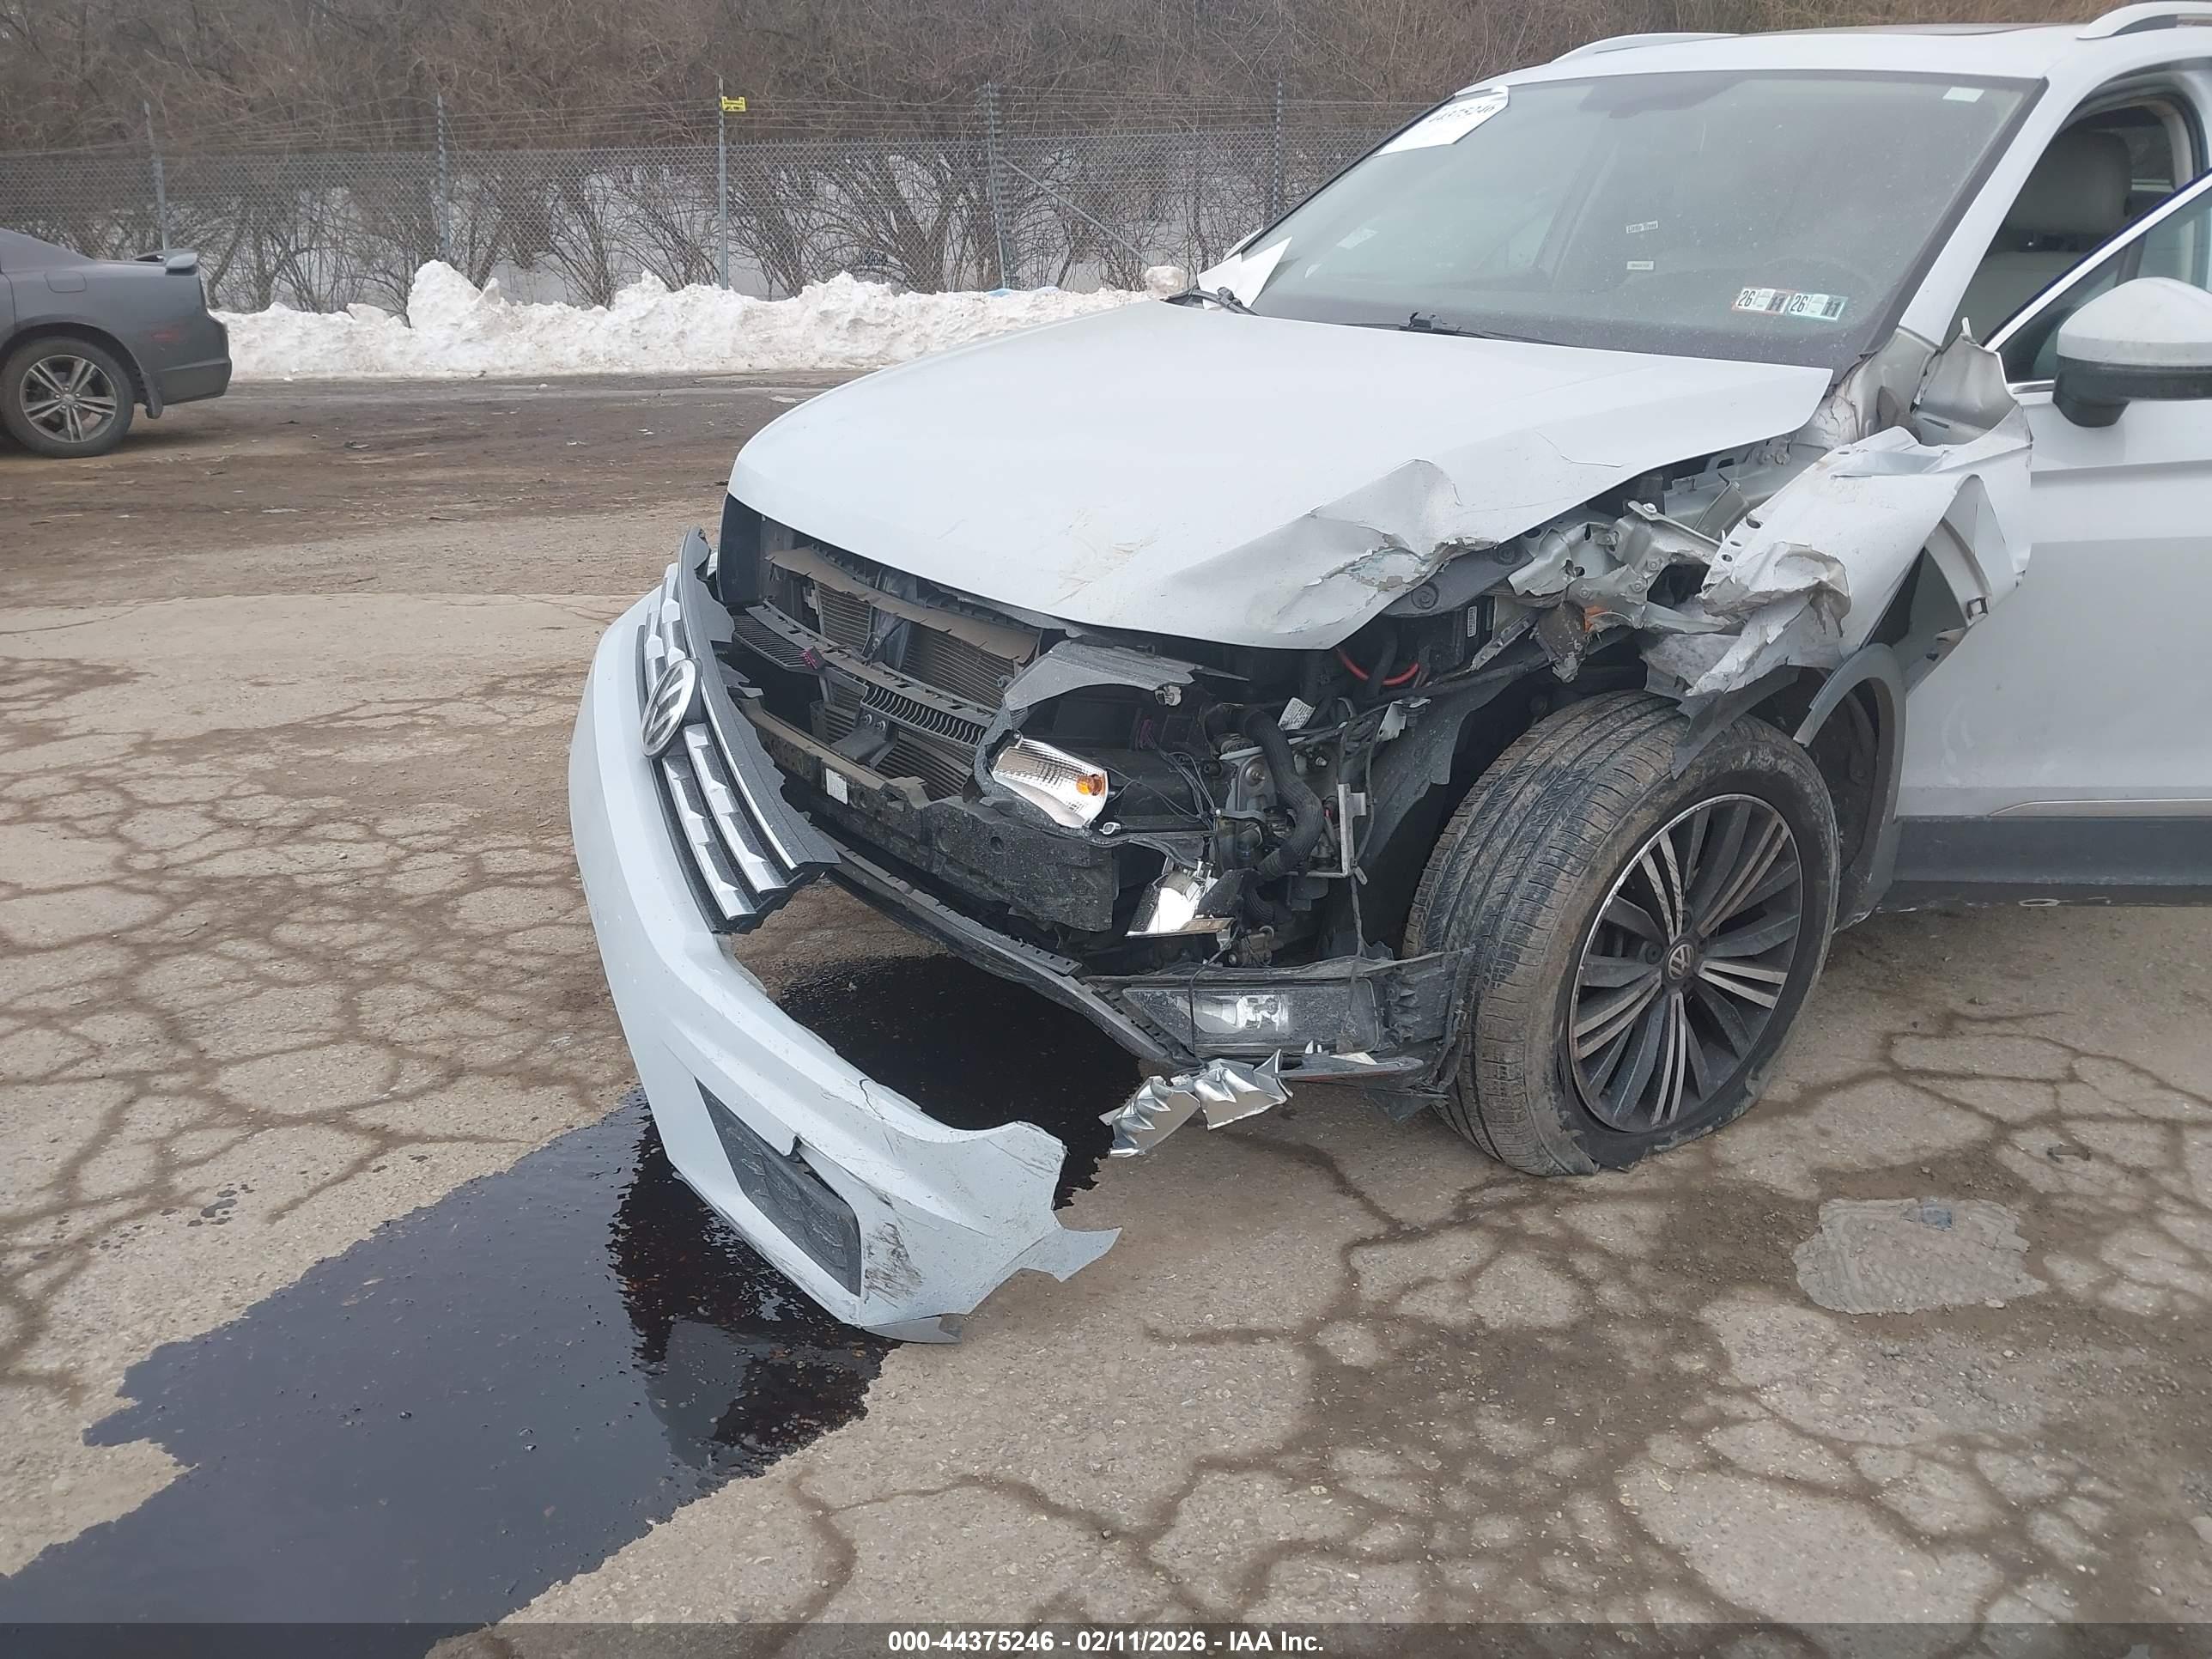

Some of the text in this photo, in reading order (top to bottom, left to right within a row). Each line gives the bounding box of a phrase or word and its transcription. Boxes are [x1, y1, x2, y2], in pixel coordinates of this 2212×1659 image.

[1737, 290, 1756, 307] 26
[1790, 295, 1809, 313] 26
[1822, 301, 1842, 317] 11
